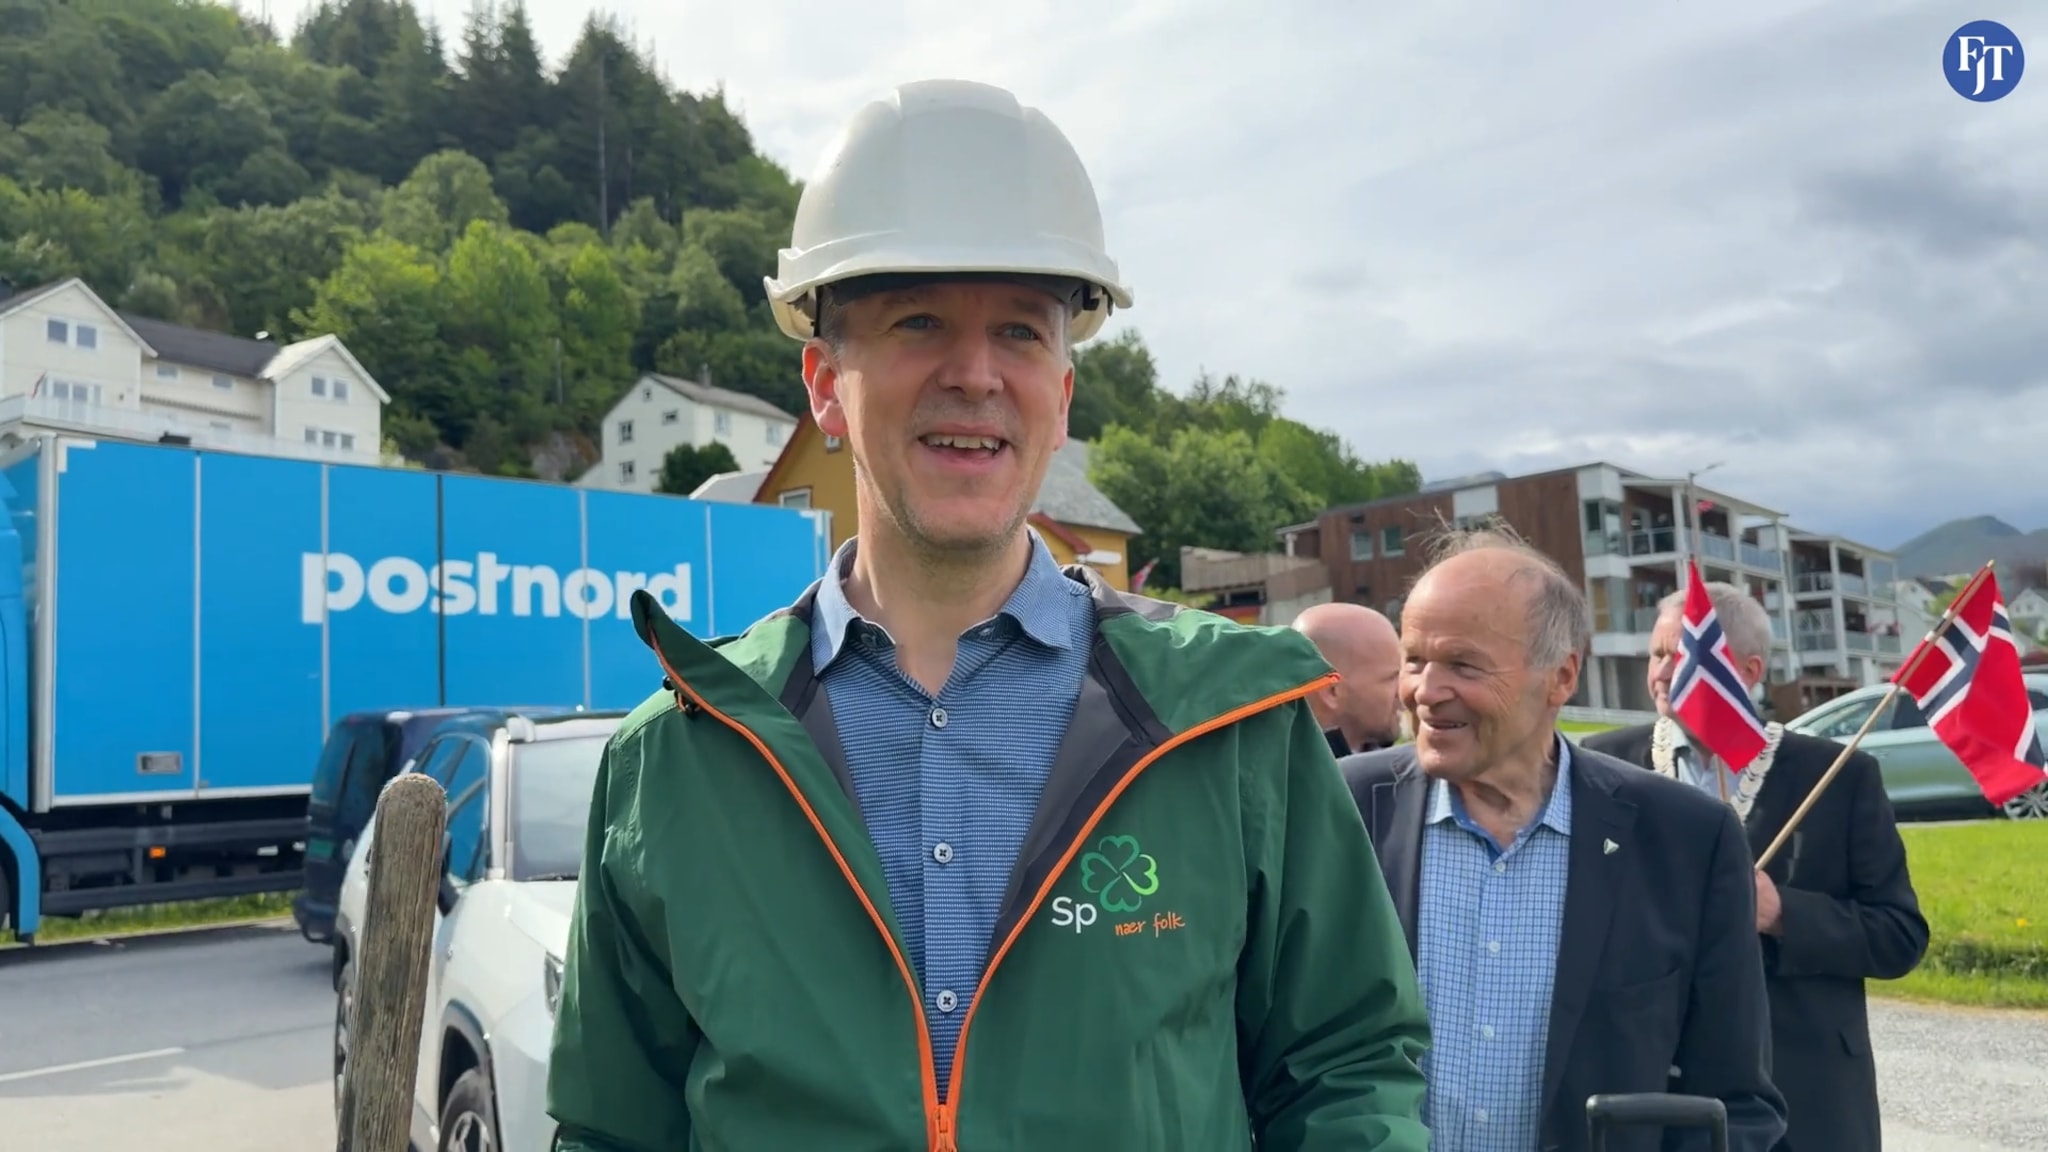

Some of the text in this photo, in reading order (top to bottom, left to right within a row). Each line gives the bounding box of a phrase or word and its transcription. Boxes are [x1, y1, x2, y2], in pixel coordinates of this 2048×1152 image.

[302, 552, 692, 624] postnord
[1051, 896, 1097, 933] Sp
[1115, 911, 1185, 938] nær folk
